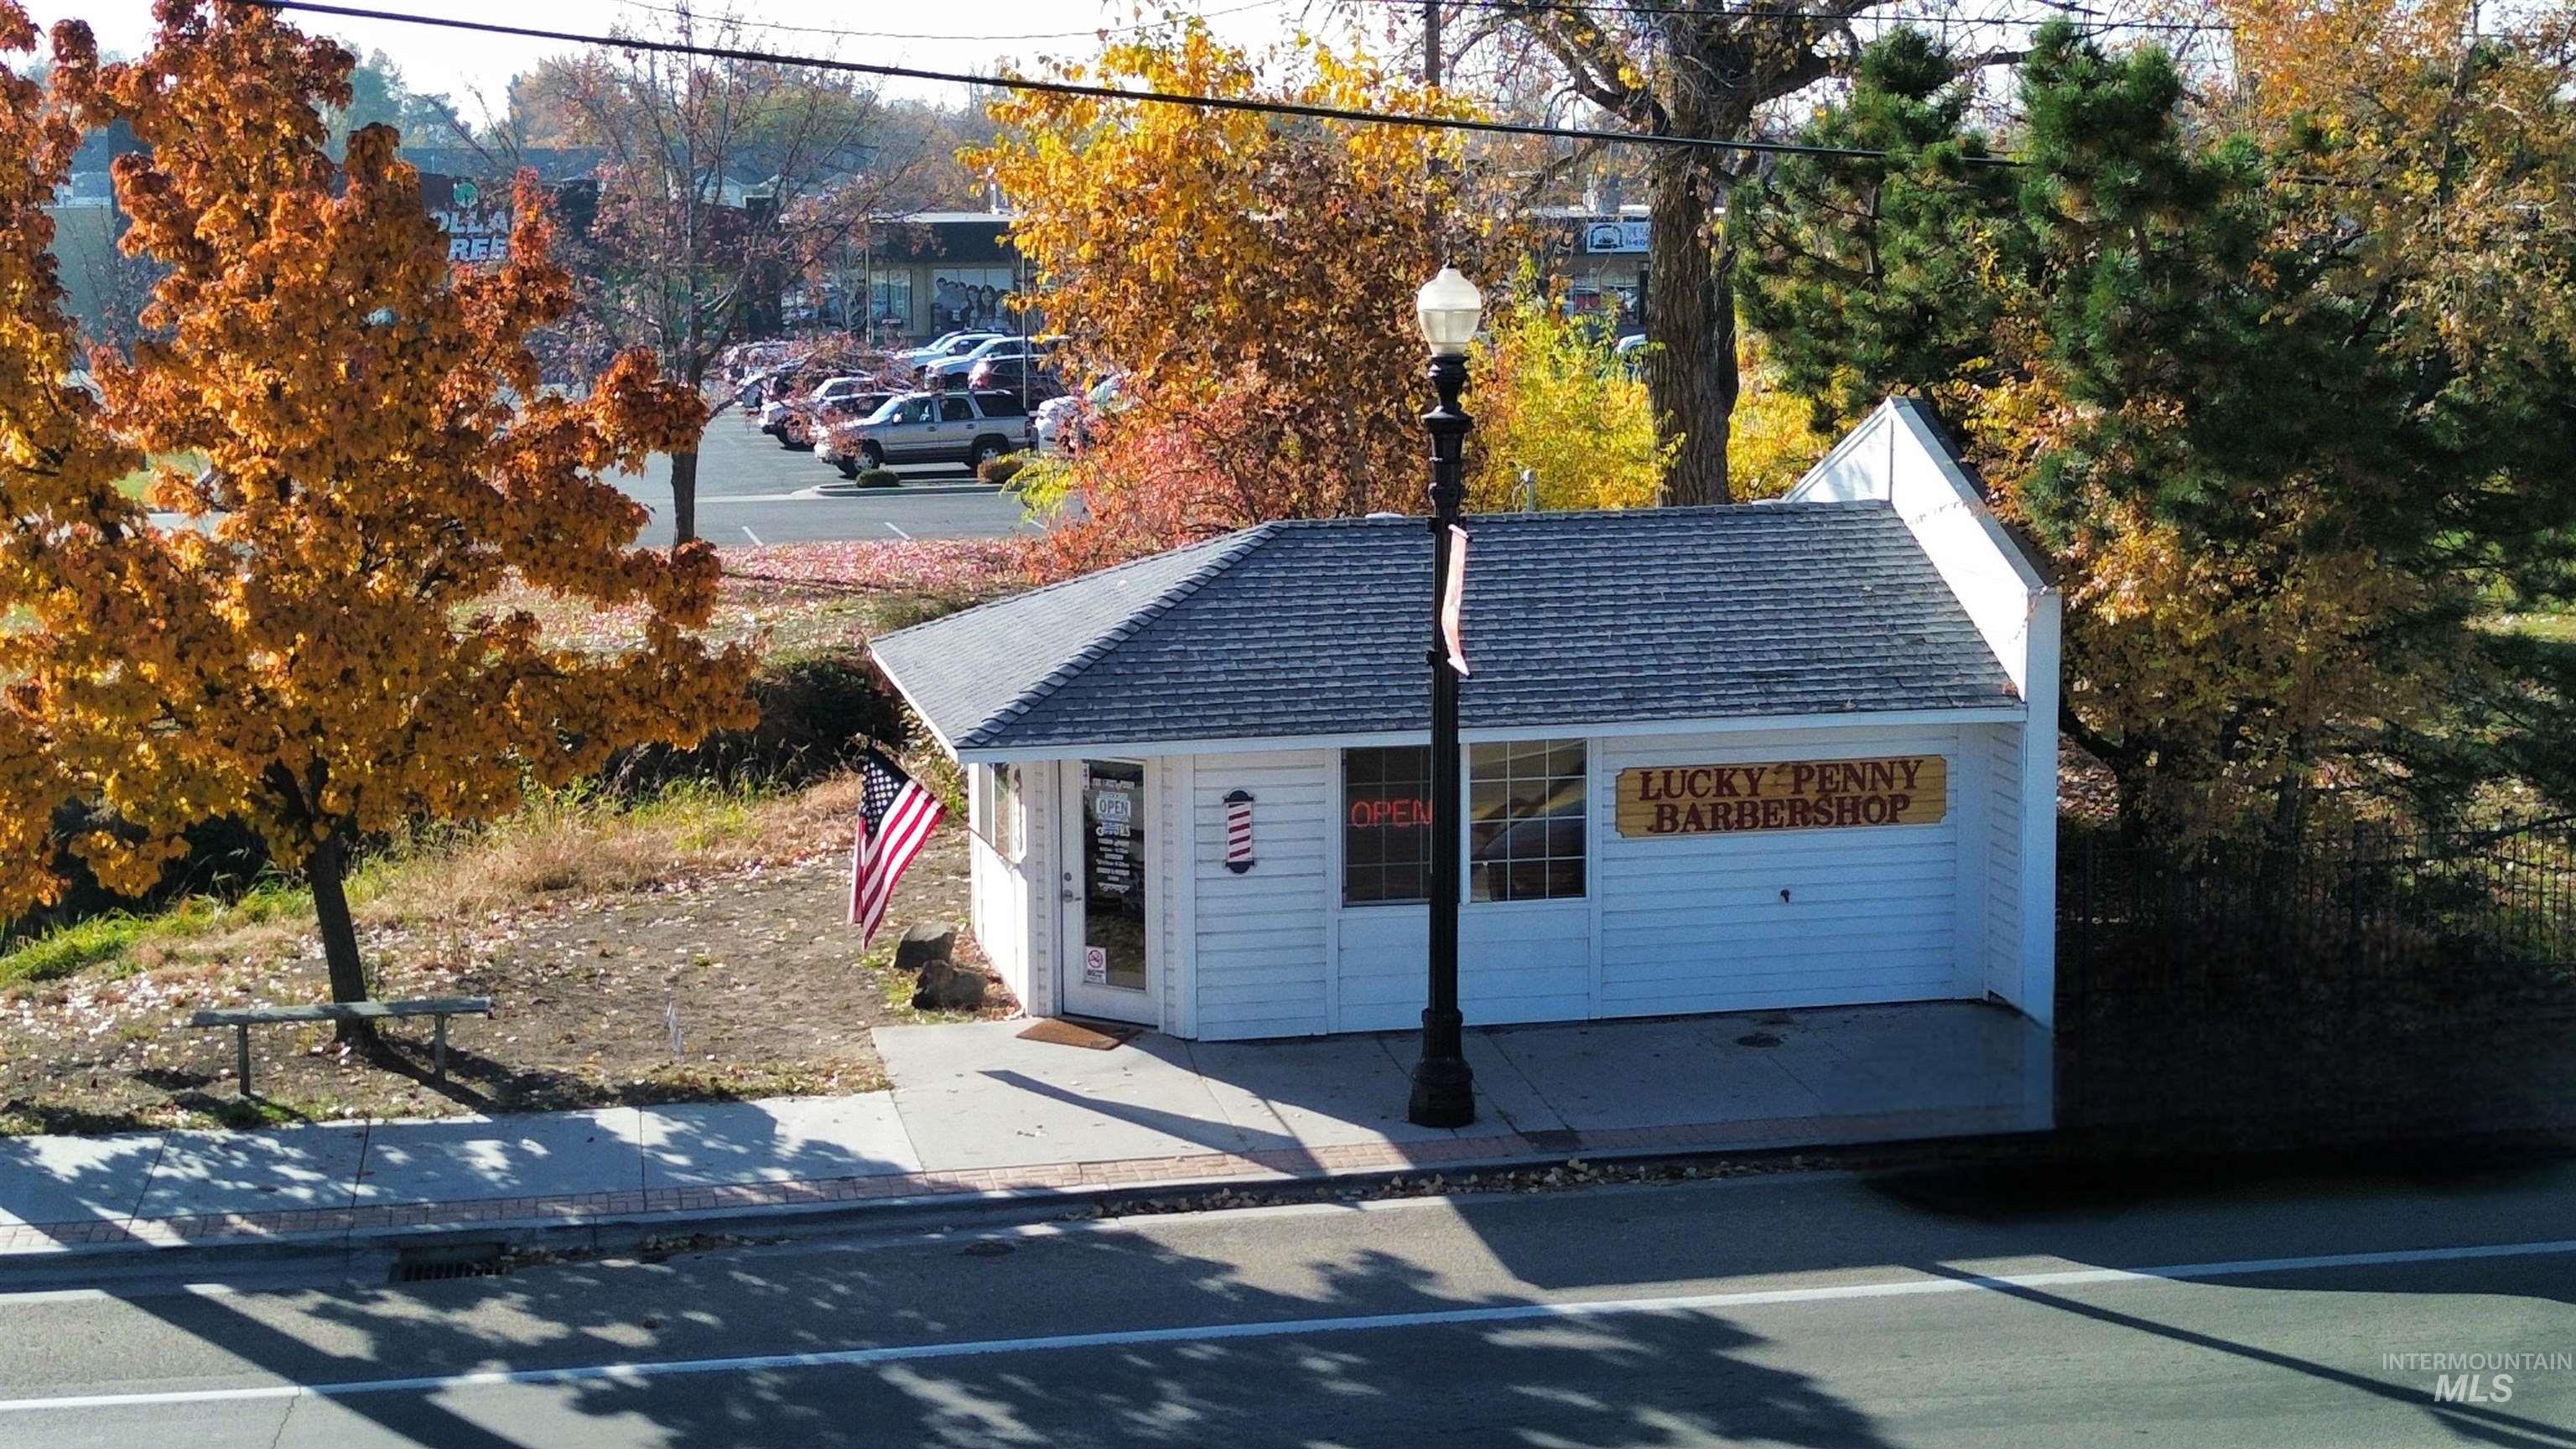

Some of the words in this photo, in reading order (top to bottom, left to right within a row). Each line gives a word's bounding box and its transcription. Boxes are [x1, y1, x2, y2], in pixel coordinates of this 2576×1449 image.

[1639, 766, 1767, 801] LUCKY
[1790, 760, 1924, 795] PENNY
[1099, 798, 1129, 814] OPEN
[1351, 799, 1434, 827] OPEN
[1649, 793, 1911, 834] BARBERSHOP
